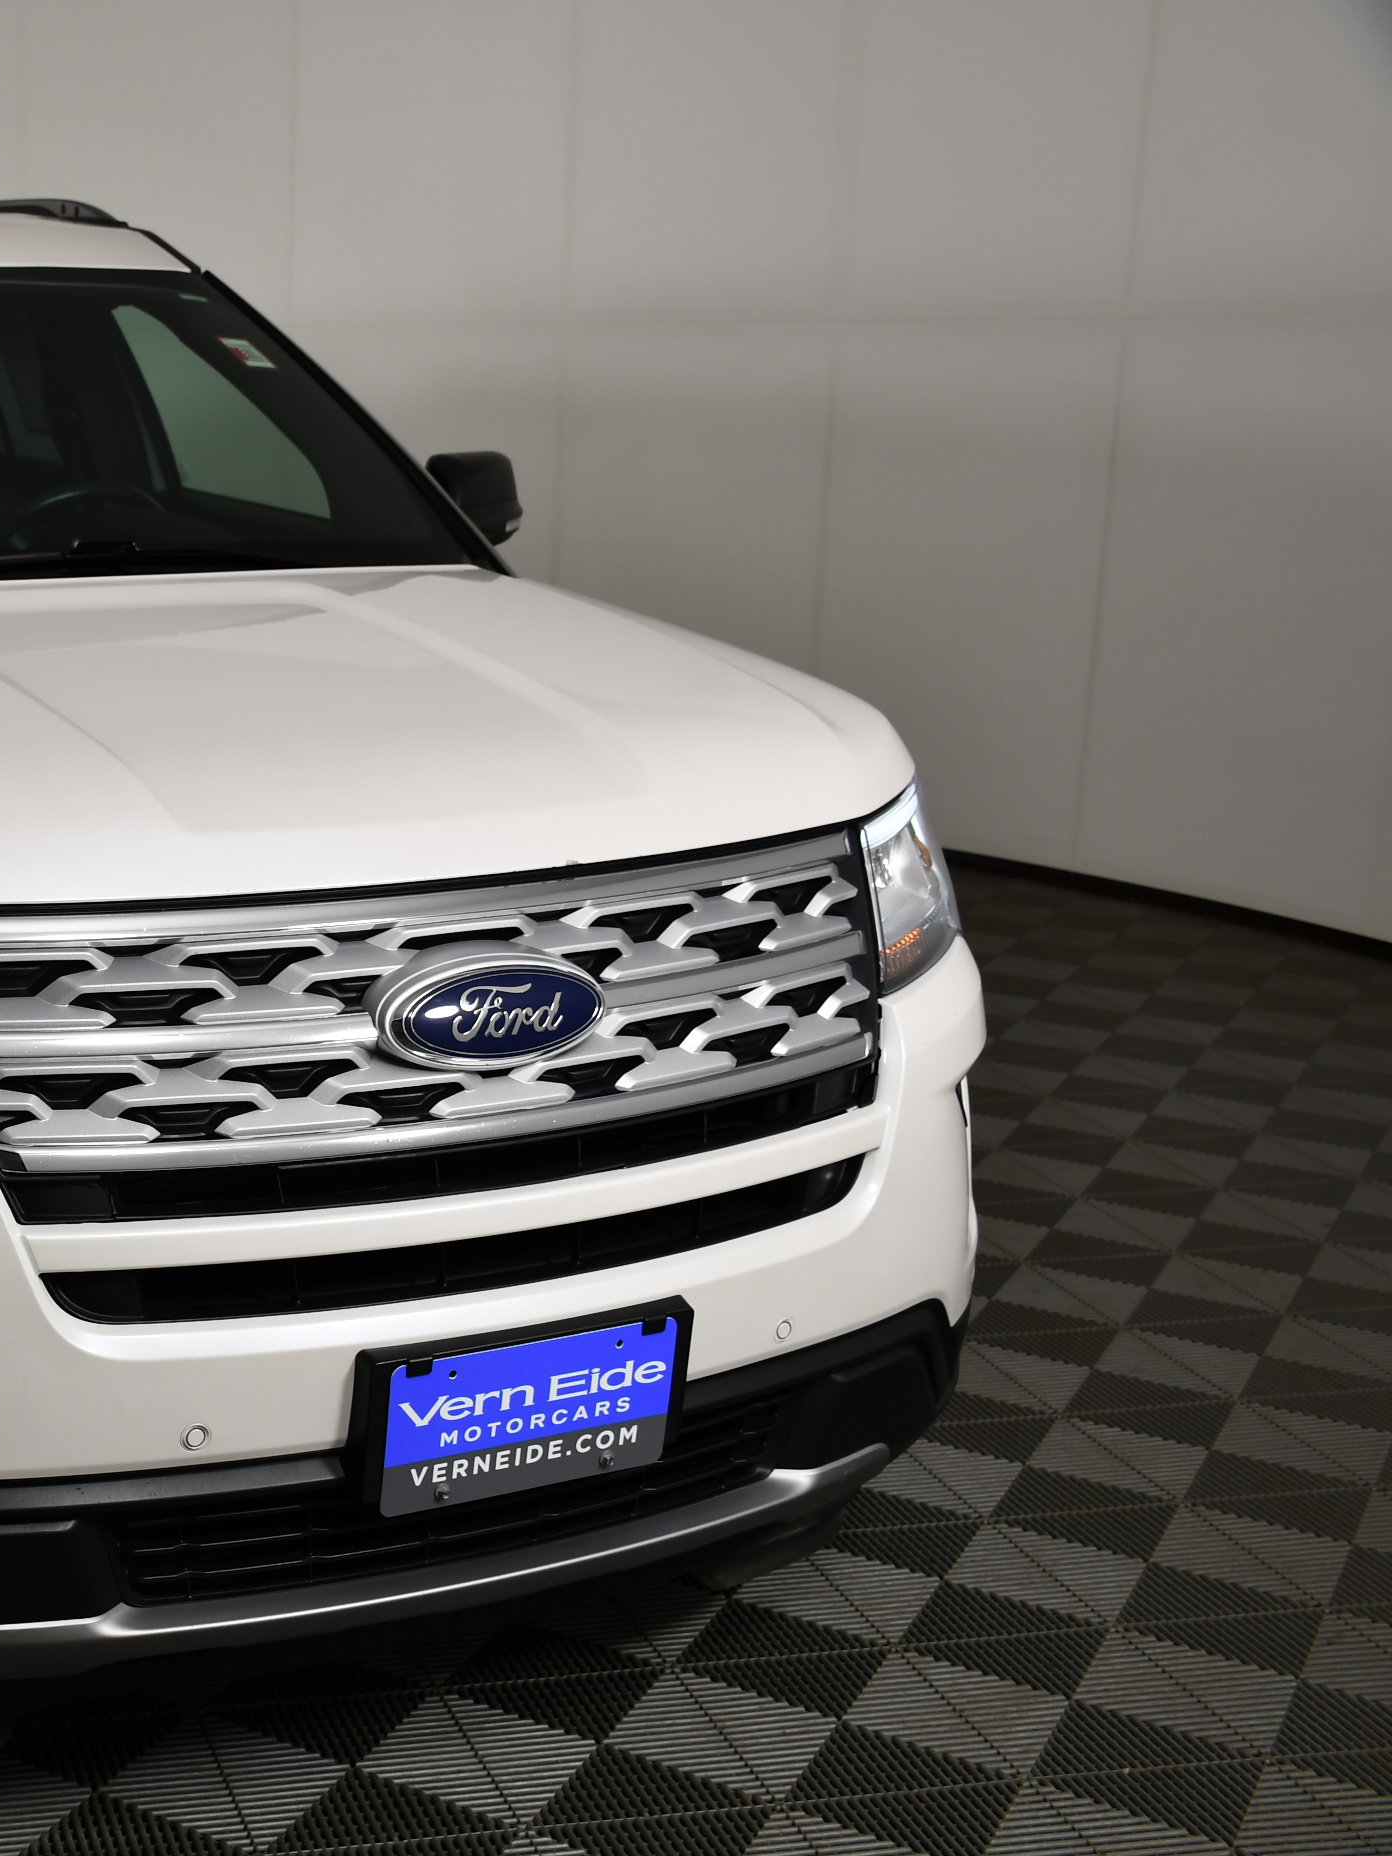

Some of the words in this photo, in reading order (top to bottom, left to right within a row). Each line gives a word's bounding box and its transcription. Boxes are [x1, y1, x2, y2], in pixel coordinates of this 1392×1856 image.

[451, 982, 563, 1043] Ford
[398, 1383, 535, 1428] Vern
[547, 1359, 667, 1402] Eide
[439, 1396, 631, 1448] MOTORCARS
[410, 1424, 639, 1488] VERNEIDE.COM
